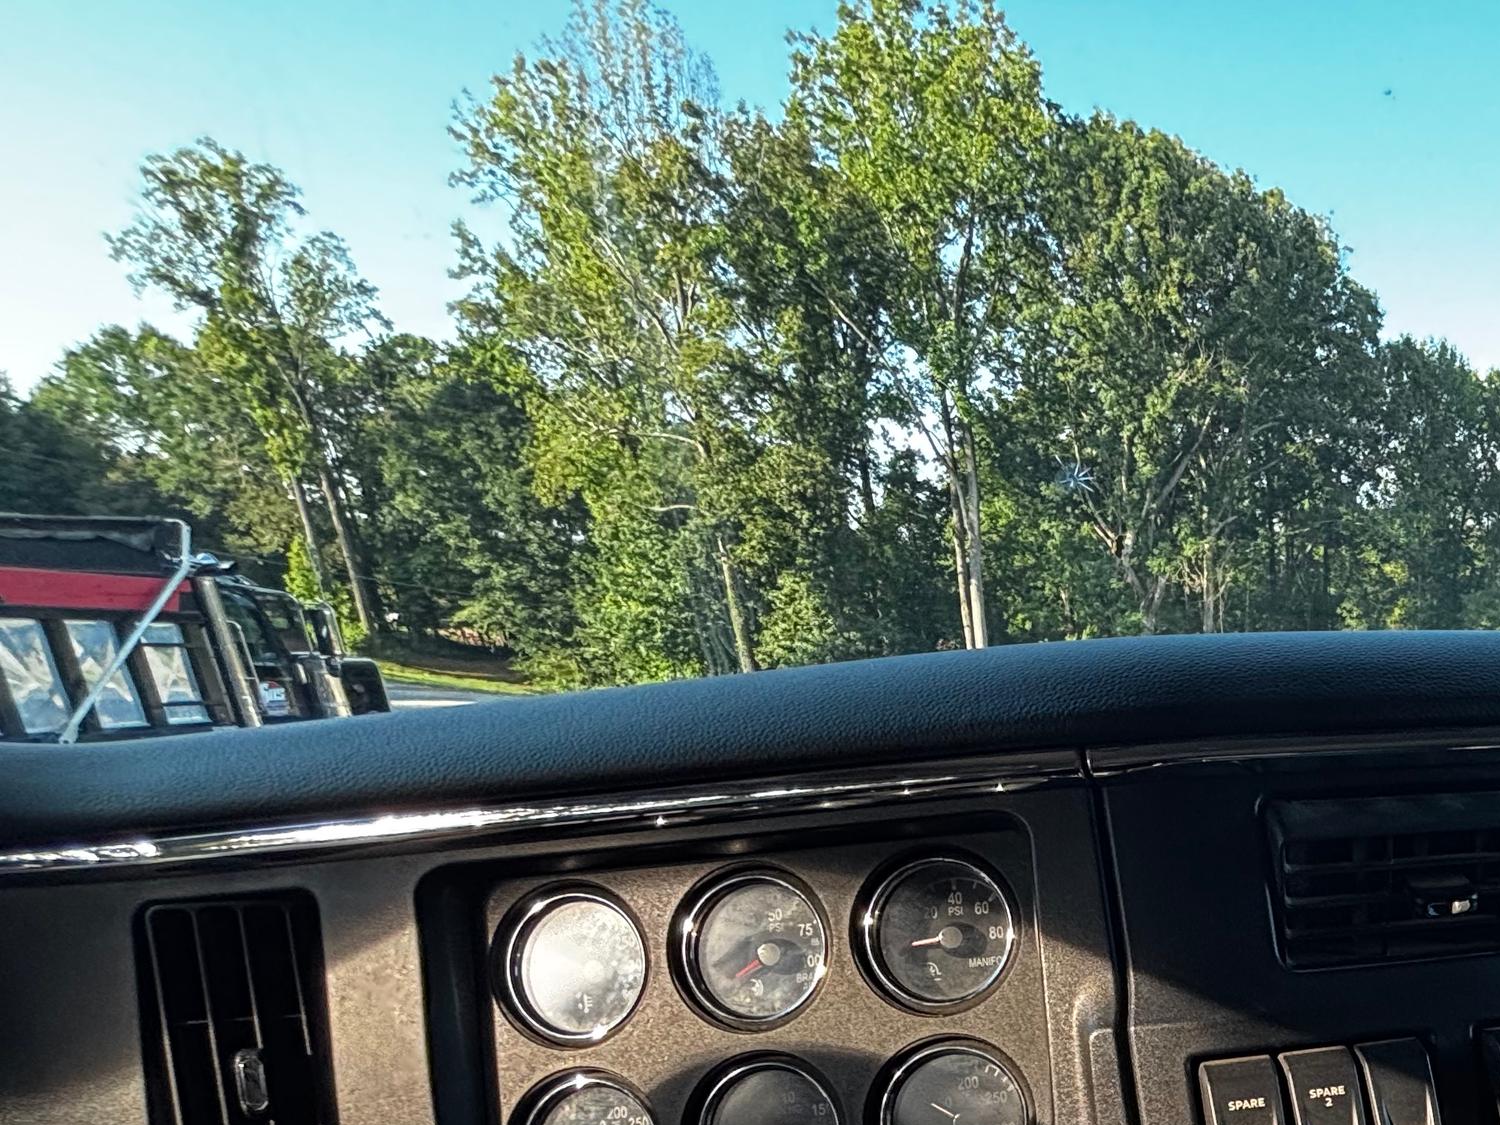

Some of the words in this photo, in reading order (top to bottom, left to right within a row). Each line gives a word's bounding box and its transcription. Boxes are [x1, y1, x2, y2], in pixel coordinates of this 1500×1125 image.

[947, 892, 962, 904] 40
[948, 906, 963, 916] PSI
[974, 901, 989, 915] 60
[798, 923, 813, 936] 75
[989, 927, 1004, 939] 80
[1309, 1085, 1346, 1099] SPARE
[1228, 1097, 1266, 1111] SPARE
[1325, 1098, 1333, 1107] 2
